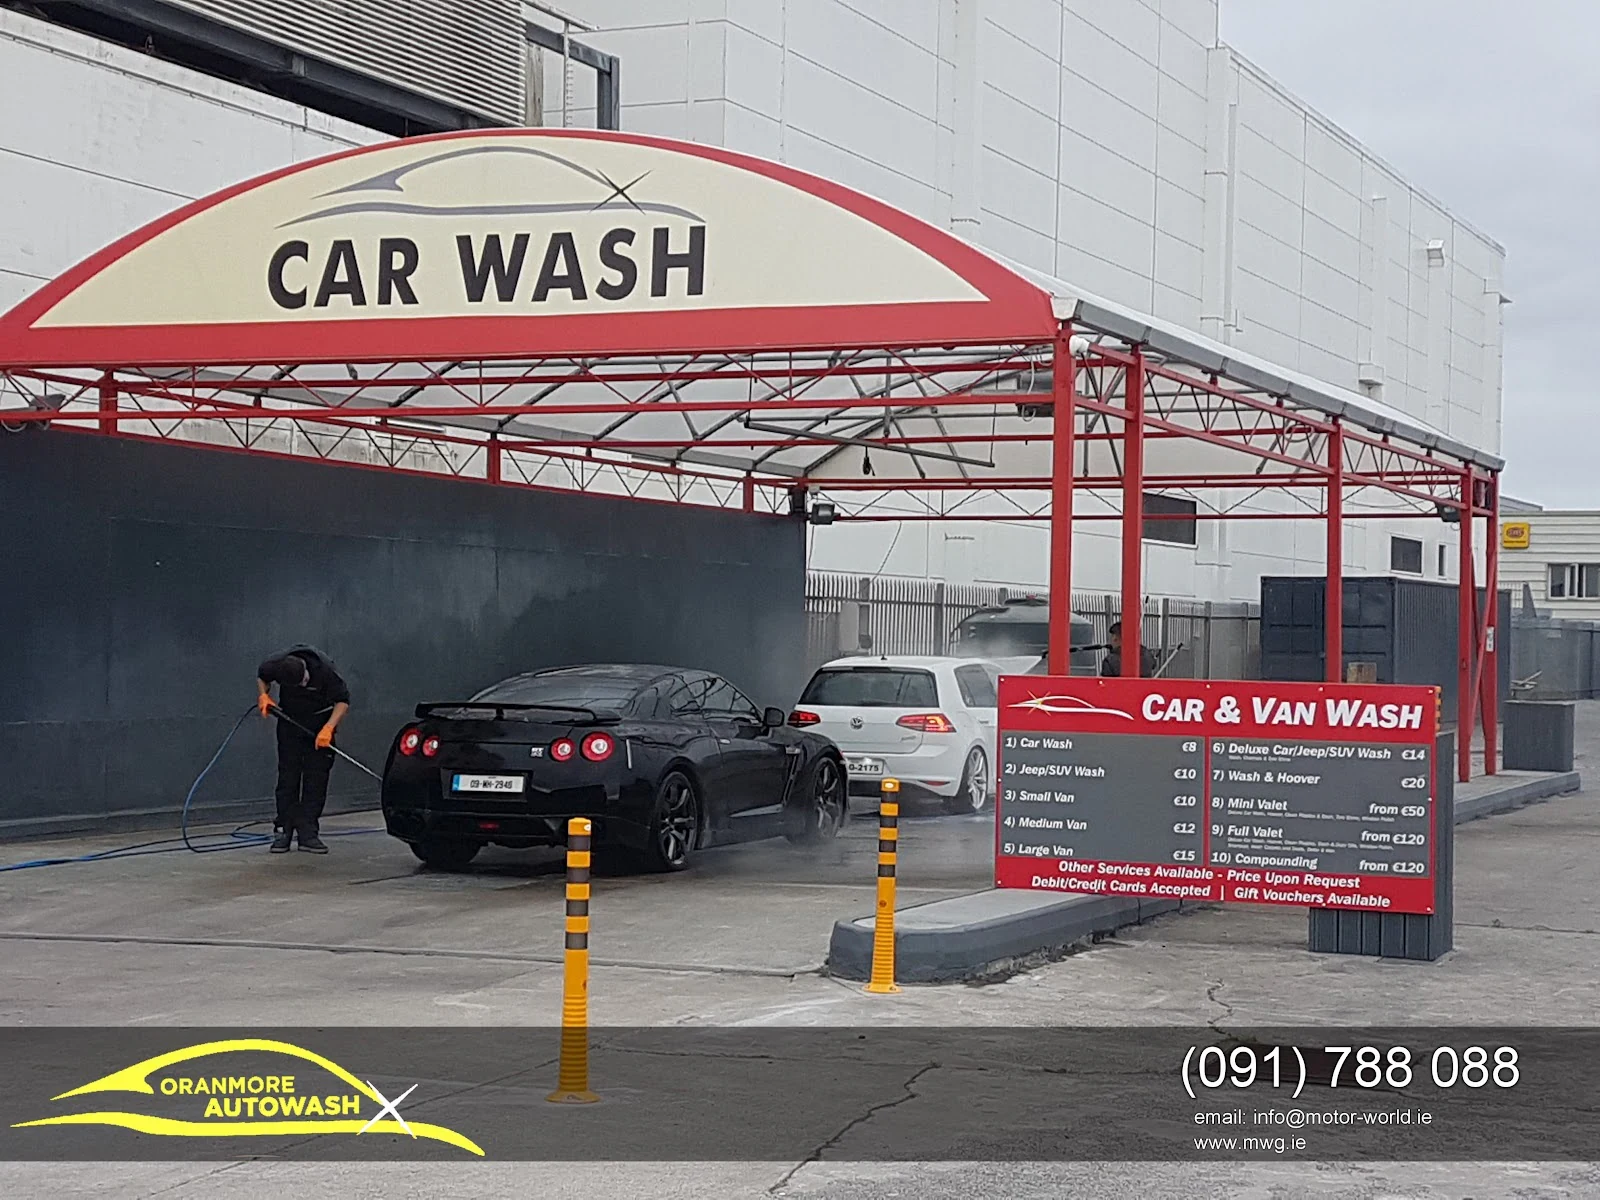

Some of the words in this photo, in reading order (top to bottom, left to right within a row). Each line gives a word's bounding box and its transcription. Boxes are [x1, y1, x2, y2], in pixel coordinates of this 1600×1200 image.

[267, 236, 420, 310] CAR
[455, 225, 707, 303] WASH
[1141, 693, 1205, 722] CAR
[1214, 695, 1241, 724] &
[1251, 697, 1317, 726] VAN
[1325, 699, 1423, 729] WASH
[1005, 738, 1017, 748] 1)
[1020, 738, 1040, 748] Car
[1042, 739, 1073, 749] Wash
[1182, 742, 1197, 752] €8
[1212, 743, 1225, 754] 6)
[1229, 743, 1269, 754] Deluxe
[1273, 745, 1355, 758] Car/Jeep/SUV
[1358, 748, 1391, 759] Wash
[1402, 750, 1425, 760] €14
[1005, 764, 1016, 774] 2)
[1019, 764, 1072, 776] Jeep/SUV
[1074, 766, 1105, 778] Wash
[1174, 769, 1196, 779] €10
[1213, 770, 1225, 781] 7)
[1229, 771, 1260, 781] Wash
[1264, 772, 1274, 782] &
[1277, 772, 1321, 784] Hoover
[1401, 778, 1425, 788] €20
[1004, 790, 1016, 801] 3)
[1019, 791, 1051, 802] Small
[1054, 792, 1074, 803] Van
[1174, 796, 1196, 807] €10
[1212, 797, 1224, 809] 8)
[1228, 798, 1254, 809] Mini
[1257, 799, 1288, 810] Valet
[1369, 803, 1398, 814] from
[1401, 806, 1425, 816] €50
[1004, 817, 1016, 828] 4)
[1018, 817, 1063, 829] Medium
[1066, 819, 1087, 830] Van
[1173, 823, 1196, 834] €12
[1212, 825, 1224, 836] 9)
[1228, 825, 1249, 836] Full
[1253, 826, 1283, 838] Valet
[1361, 831, 1390, 842] from
[1393, 834, 1425, 845] €120
[1004, 843, 1015, 854] 5)
[1018, 844, 1050, 856] Large
[1053, 845, 1073, 856] Van
[1173, 850, 1195, 860] €15
[1211, 852, 1231, 864] 10)
[1235, 853, 1318, 870] Compounding
[1359, 860, 1388, 872] from
[1393, 863, 1425, 873] €120
[1059, 861, 1094, 873] Other
[1097, 862, 1150, 876] Services
[1154, 866, 1214, 880] Available
[1227, 870, 1261, 882] Price
[1265, 872, 1300, 886] Upon
[1304, 874, 1360, 889] Request
[1031, 876, 1106, 892] Debit/Credit
[1110, 881, 1146, 893] Cards
[1150, 882, 1211, 898] Accepted
[1235, 887, 1258, 899] Gift
[1263, 889, 1324, 903] Vouchers
[1327, 893, 1390, 907] Available
